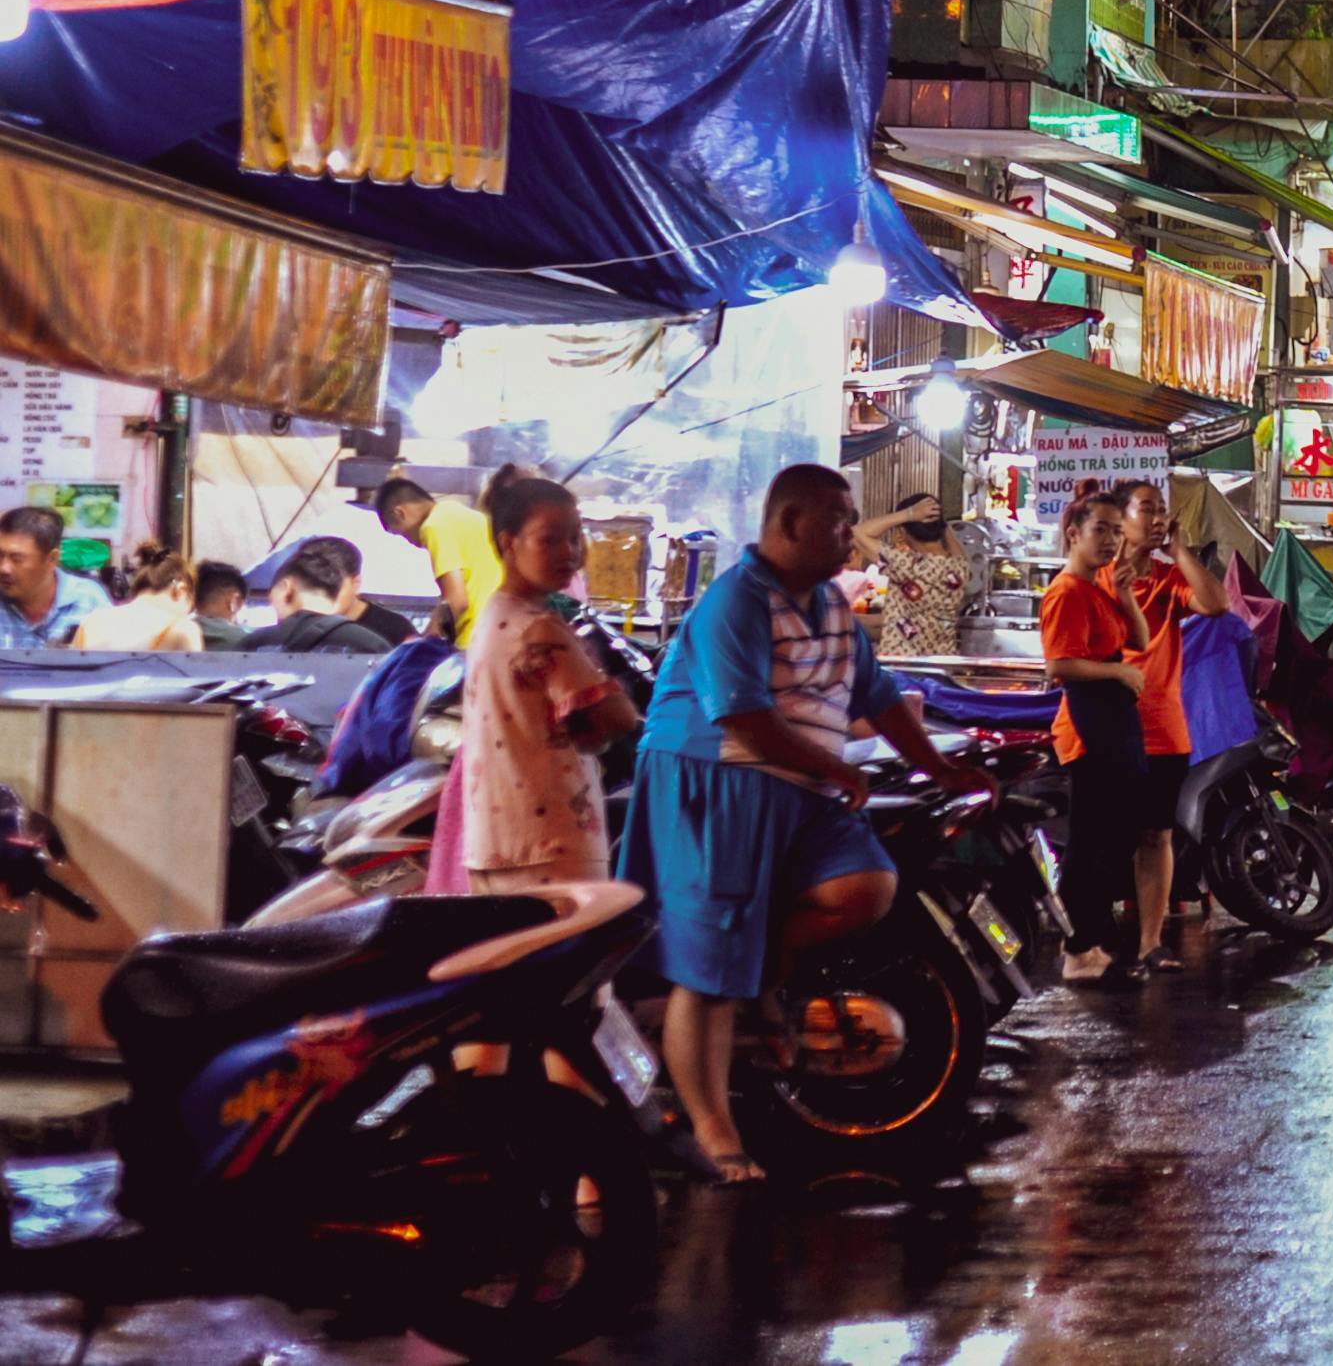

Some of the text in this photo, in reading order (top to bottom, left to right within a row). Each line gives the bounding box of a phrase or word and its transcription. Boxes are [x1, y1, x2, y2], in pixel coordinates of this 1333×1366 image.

[1037, 438, 1064, 451] RAU
[1068, 434, 1088, 450] MÁ
[1102, 436, 1129, 452] ĐẬU
[1134, 434, 1169, 448] XANH
[1038, 452, 1167, 472] HỒNG TRÀ SỦI BỌT
[1038, 477, 1075, 493] NƯỚ
[1038, 499, 1064, 514] SỮ
